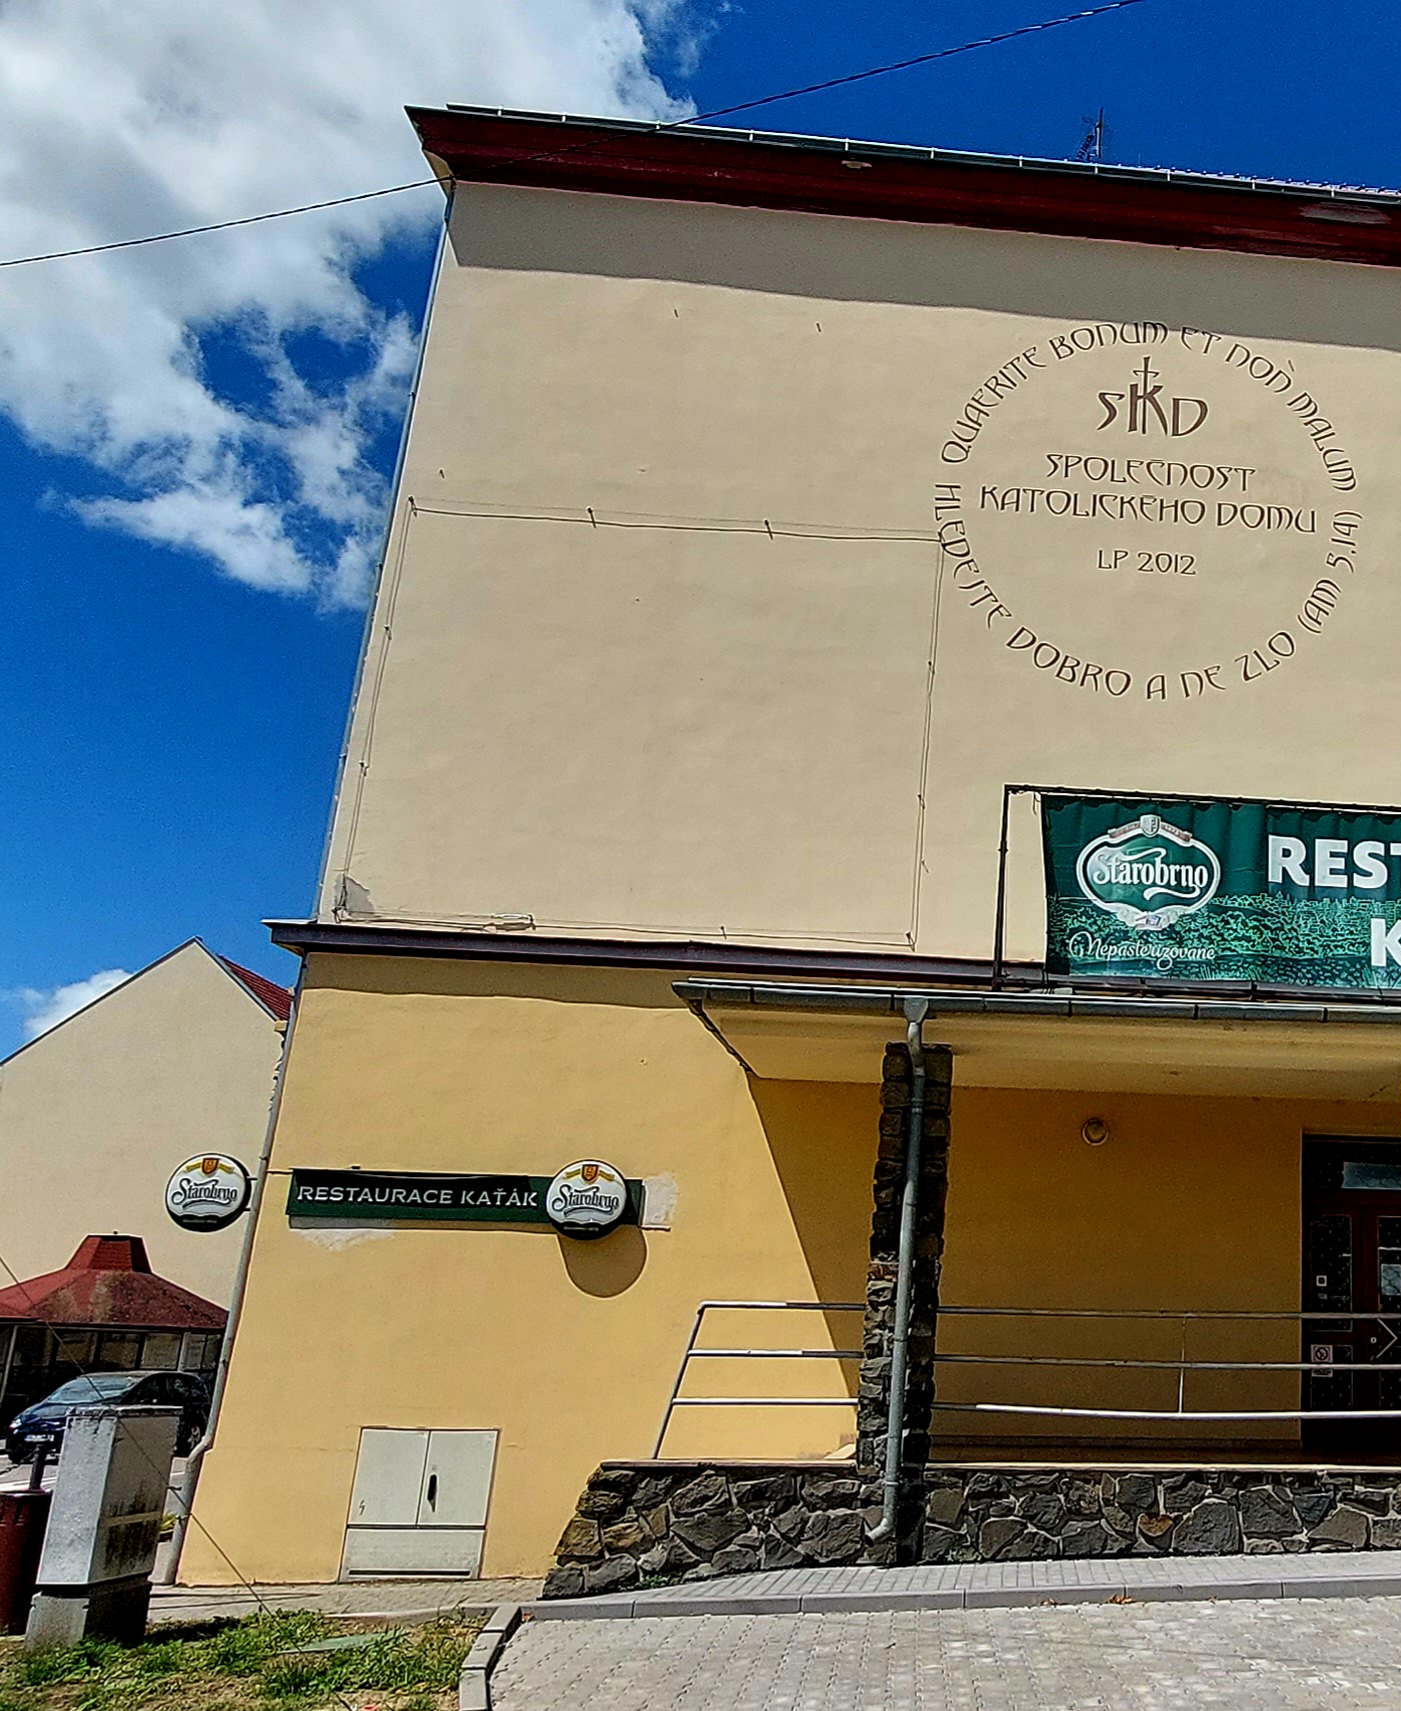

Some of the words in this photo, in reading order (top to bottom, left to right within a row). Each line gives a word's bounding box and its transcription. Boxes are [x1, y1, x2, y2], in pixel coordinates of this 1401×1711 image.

[942, 346, 1047, 463] QUAERITE
[1048, 321, 1169, 360] BONUM
[1181, 326, 1222, 354] ET
[1287, 392, 1357, 491] MALUM
[1097, 383, 1209, 436] SKD
[1217, 502, 1316, 533] DOMU
[1098, 550, 1129, 570] LP
[1137, 552, 1197, 575] 2012
[935, 483, 1012, 630] HLEDEJTE
[1006, 626, 1132, 697] DOBRO
[1146, 674, 1166, 700] A
[1180, 665, 1227, 699] NE
[1234, 631, 1296, 681] ZLO
[1092, 847, 1209, 901] Starobrno
[171, 1178, 238, 1209] Starobrno
[297, 1185, 454, 1204] RESTAURACE
[460, 1188, 539, 1207] KAŤÁK
[551, 1184, 619, 1217] Starobrno
